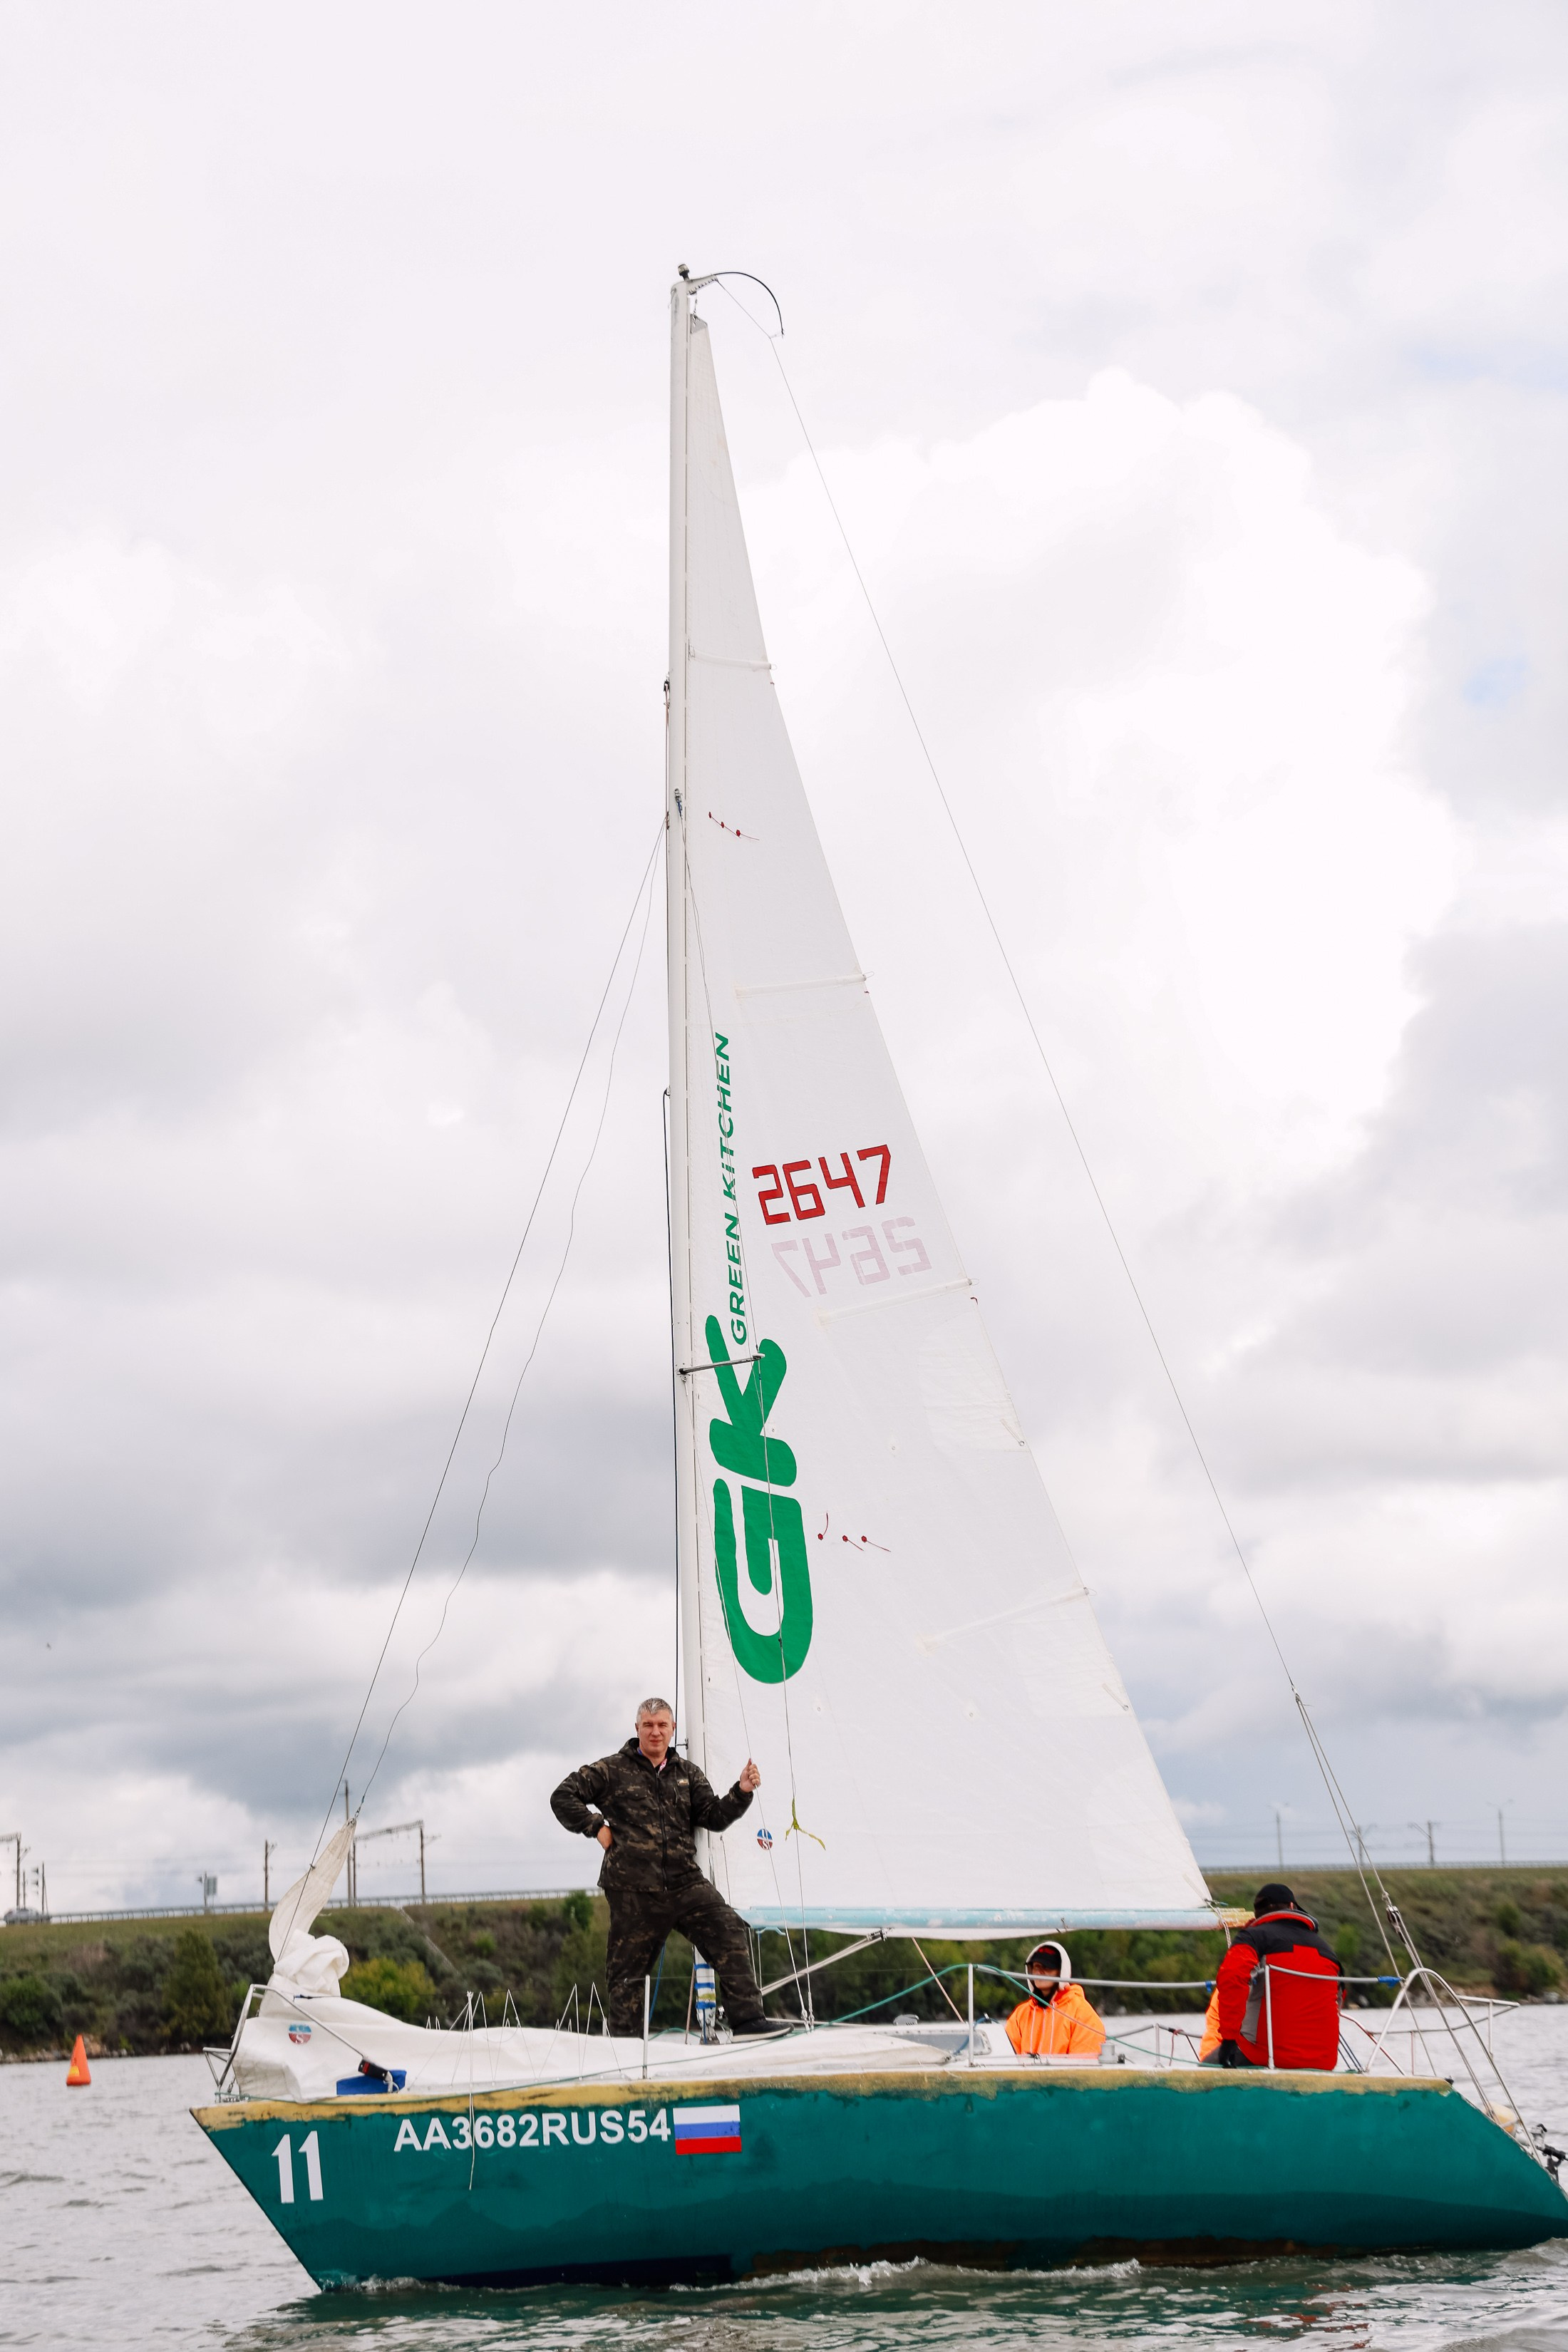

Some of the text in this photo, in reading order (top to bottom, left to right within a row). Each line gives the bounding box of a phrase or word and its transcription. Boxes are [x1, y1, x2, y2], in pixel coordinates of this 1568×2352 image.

[752, 1144, 891, 1225] 2647
[724, 1212, 748, 1346] GREEN
[272, 2130, 324, 2204] 11
[393, 2108, 671, 2152] AA3682RUS54
